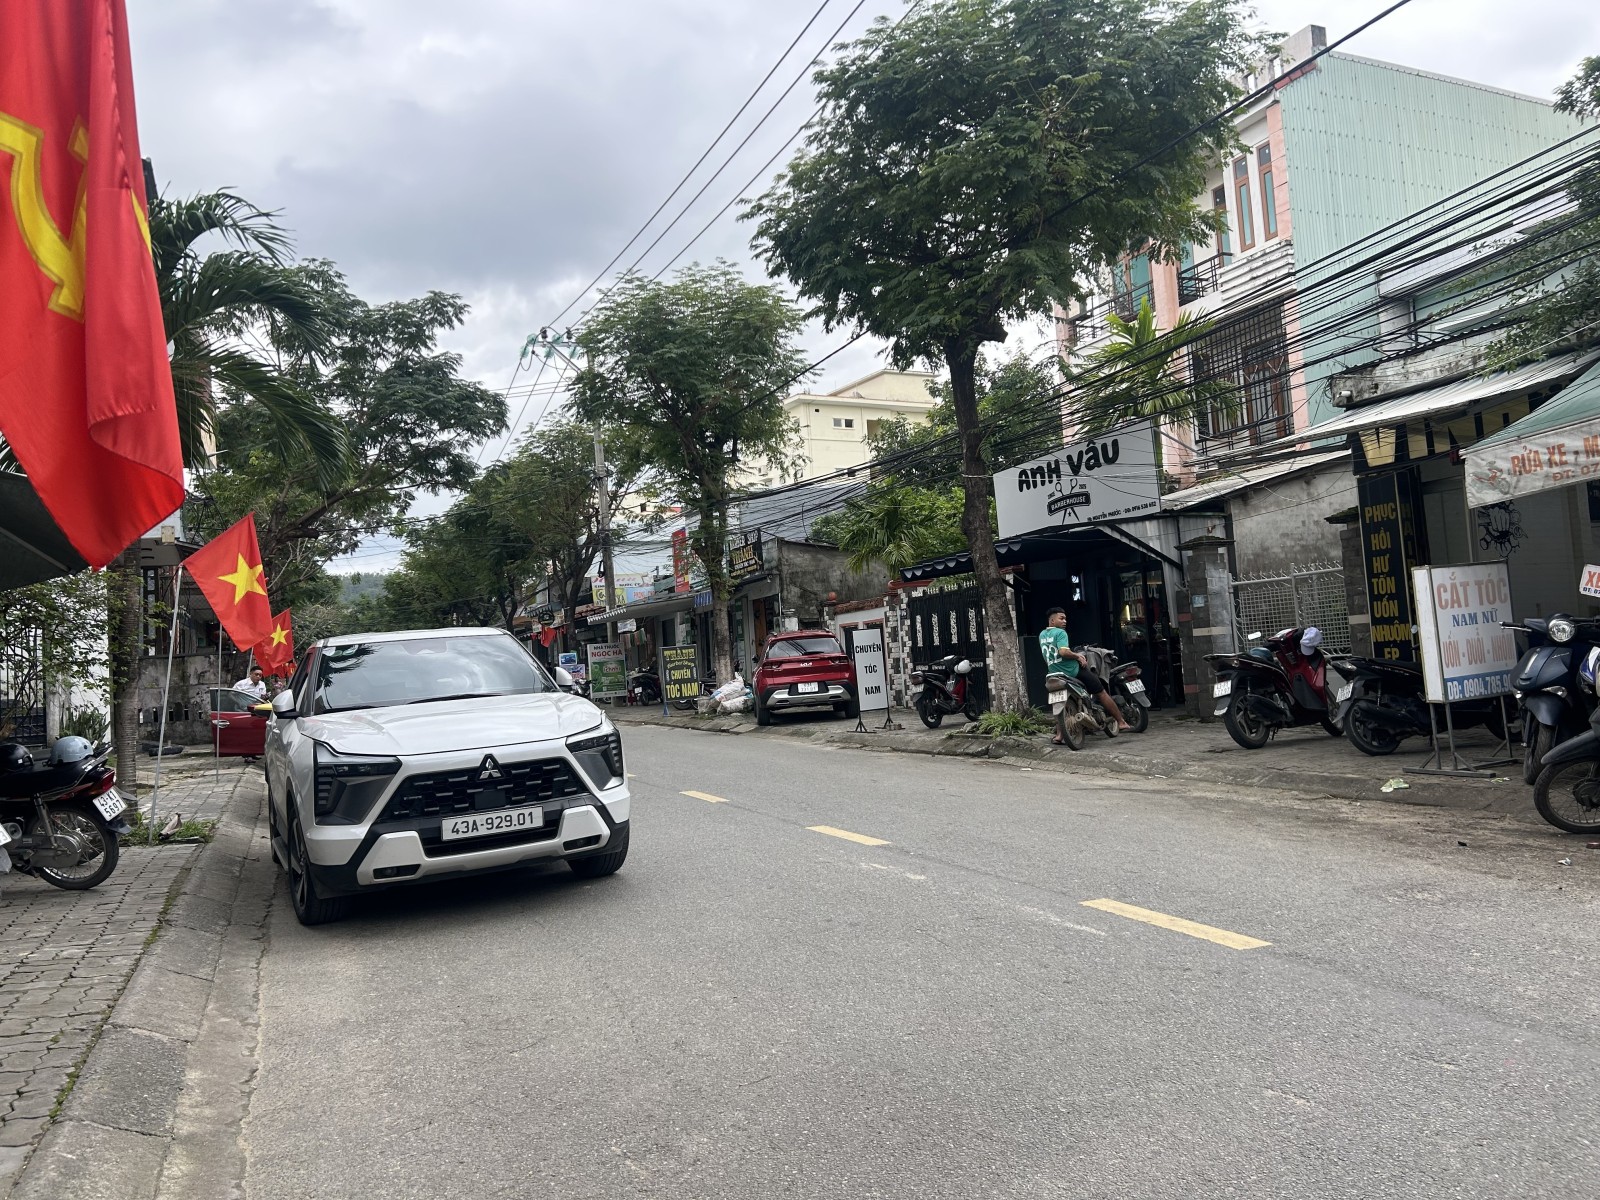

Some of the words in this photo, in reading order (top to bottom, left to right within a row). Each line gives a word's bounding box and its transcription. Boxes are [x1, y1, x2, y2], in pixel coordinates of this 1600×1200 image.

[1546, 443, 1569, 469] XE
[1364, 502, 1397, 524] PHỤC
[1370, 527, 1392, 550] HỒI
[1372, 553, 1390, 574] HƯ
[1436, 571, 1470, 610] CẮT
[1474, 573, 1508, 606] TÓC
[1452, 612, 1479, 627] NAM
[1481, 608, 1498, 624] NỮ
[1371, 620, 1411, 644] NHUỘM
[855, 642, 882, 654] CHUYÊN
[670, 667, 691, 680] CHUYÊN
[864, 663, 878, 674] TÓC
[665, 682, 681, 699] TÓC
[681, 682, 699, 698] NAM
[864, 685, 881, 695] NAM
[103, 798, 123, 817] 5697
[451, 811, 534, 835] 43A-929.01
